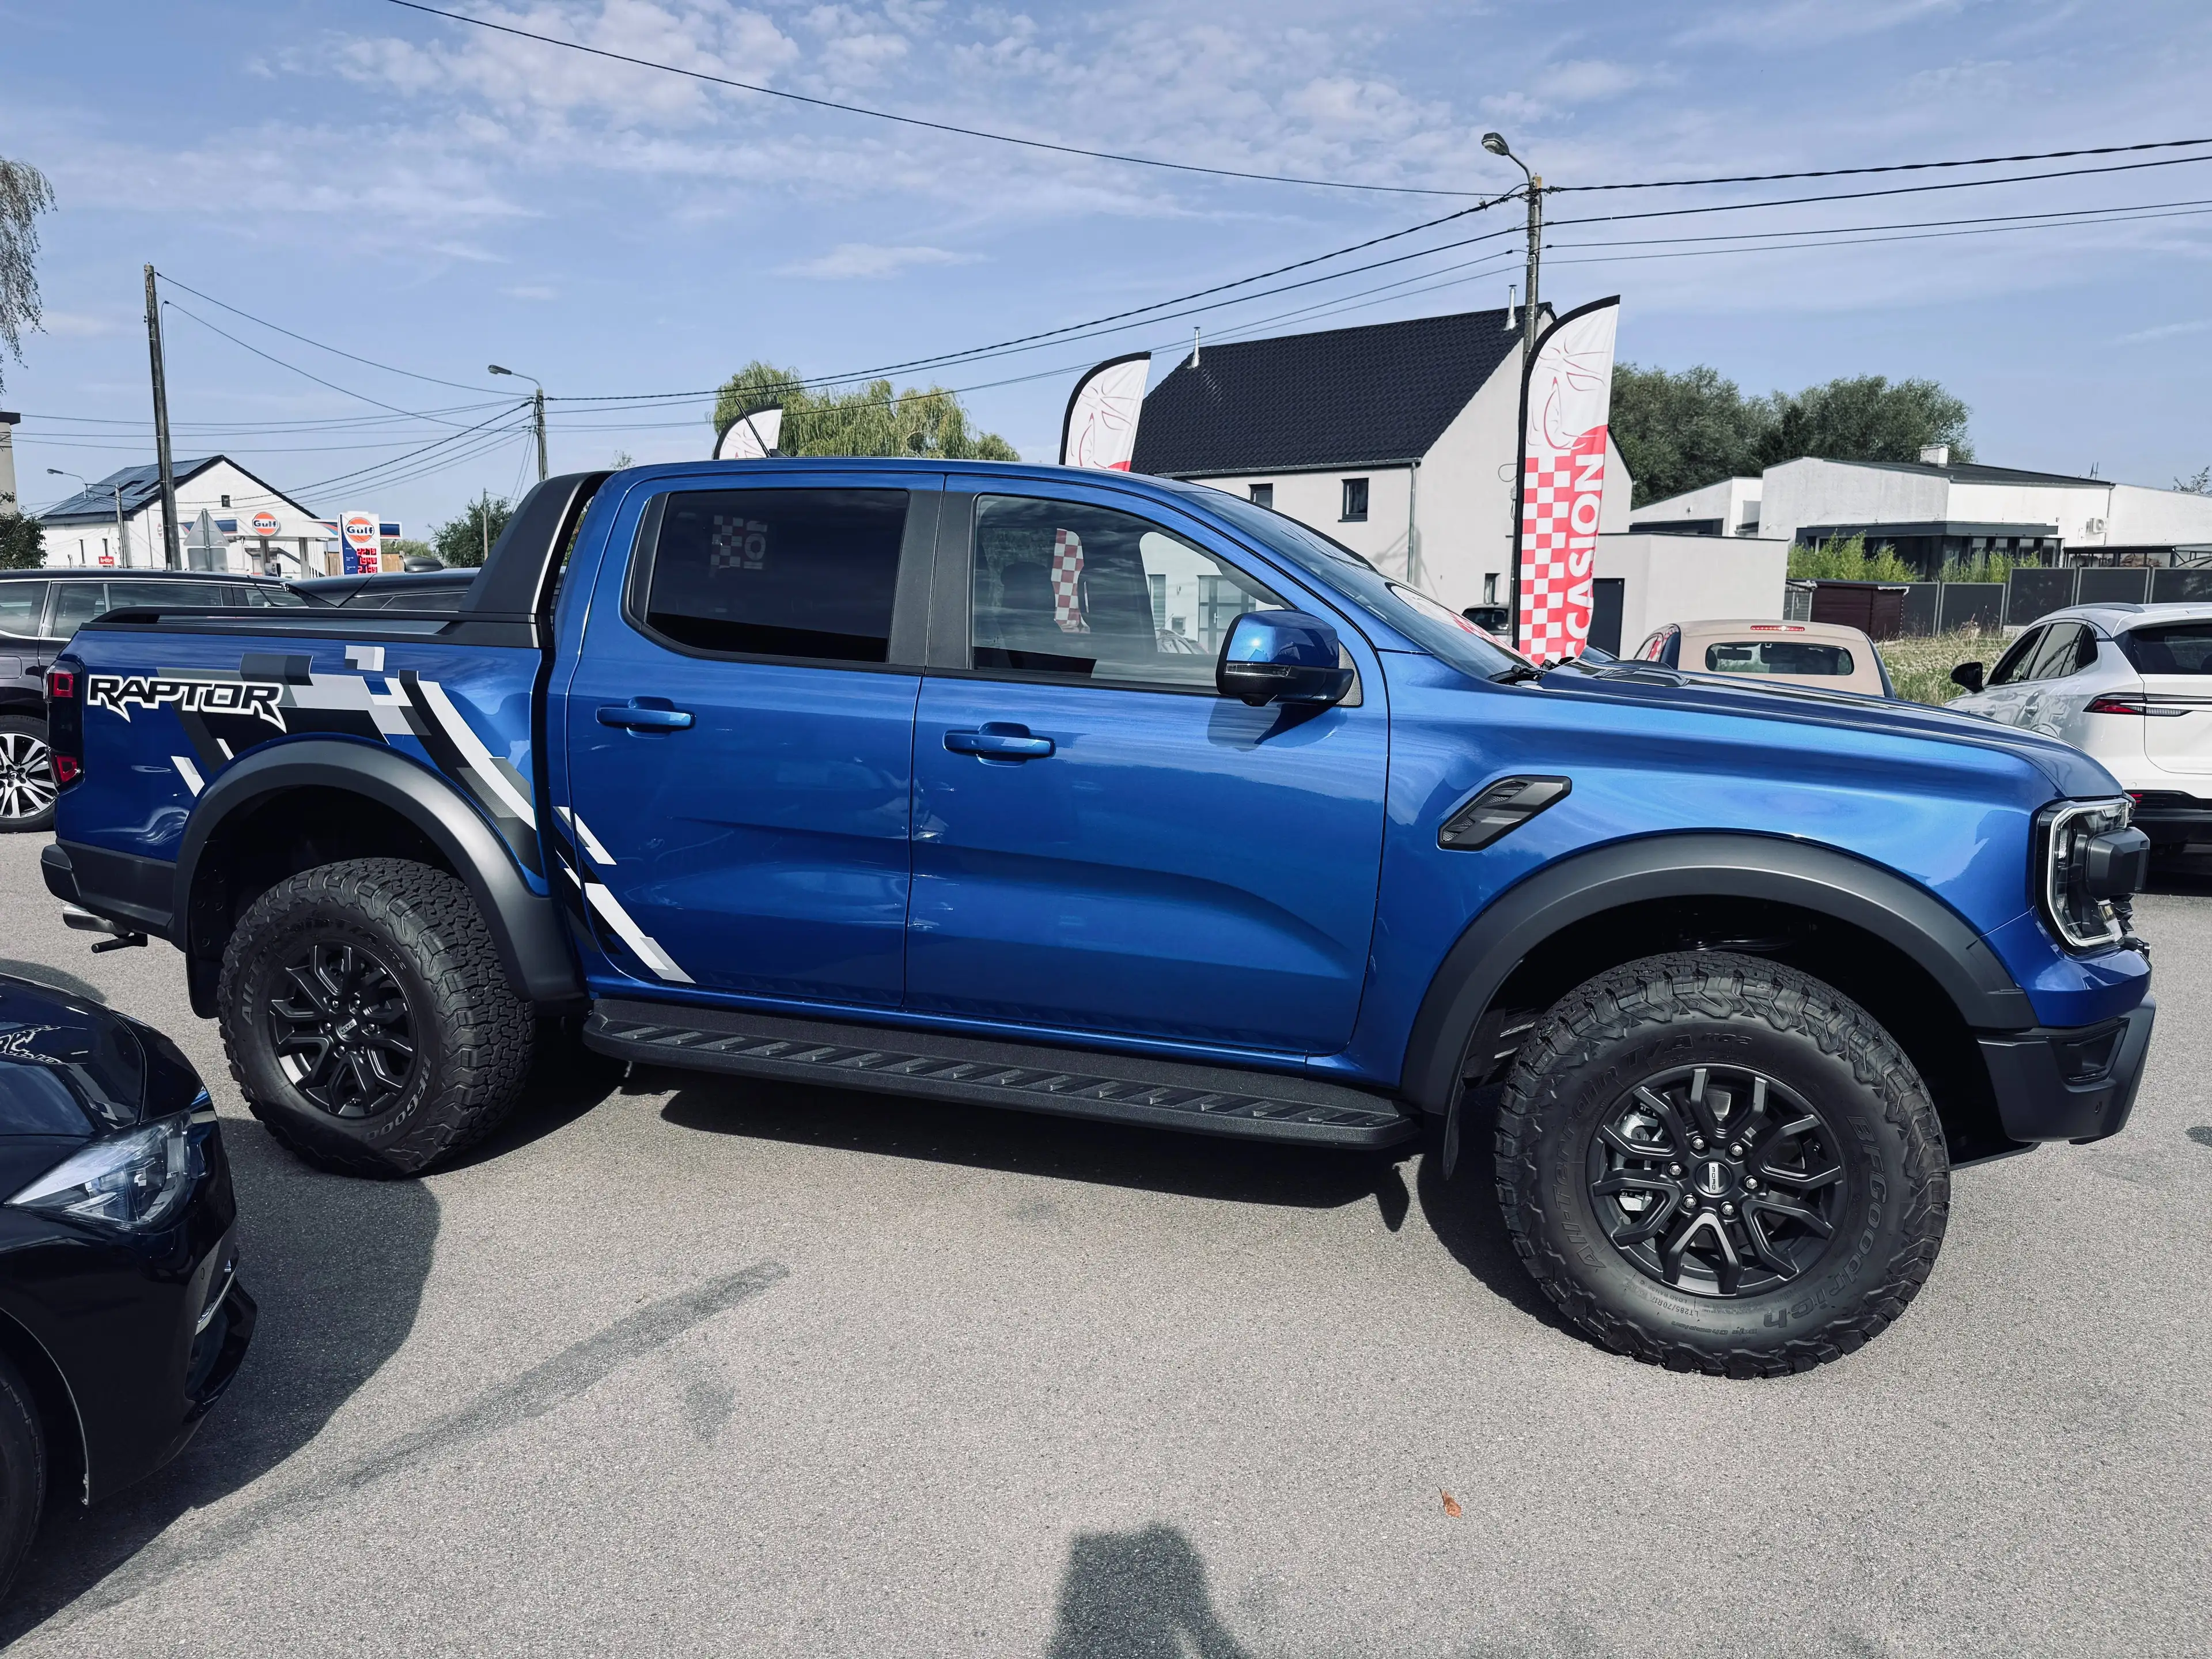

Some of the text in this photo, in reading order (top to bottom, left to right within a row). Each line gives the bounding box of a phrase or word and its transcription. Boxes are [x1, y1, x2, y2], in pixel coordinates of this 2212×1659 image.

[347, 526, 373, 534] Gulf
[88, 674, 287, 734] RAPTOR
[1669, 1294, 1687, 1304] LOAD
